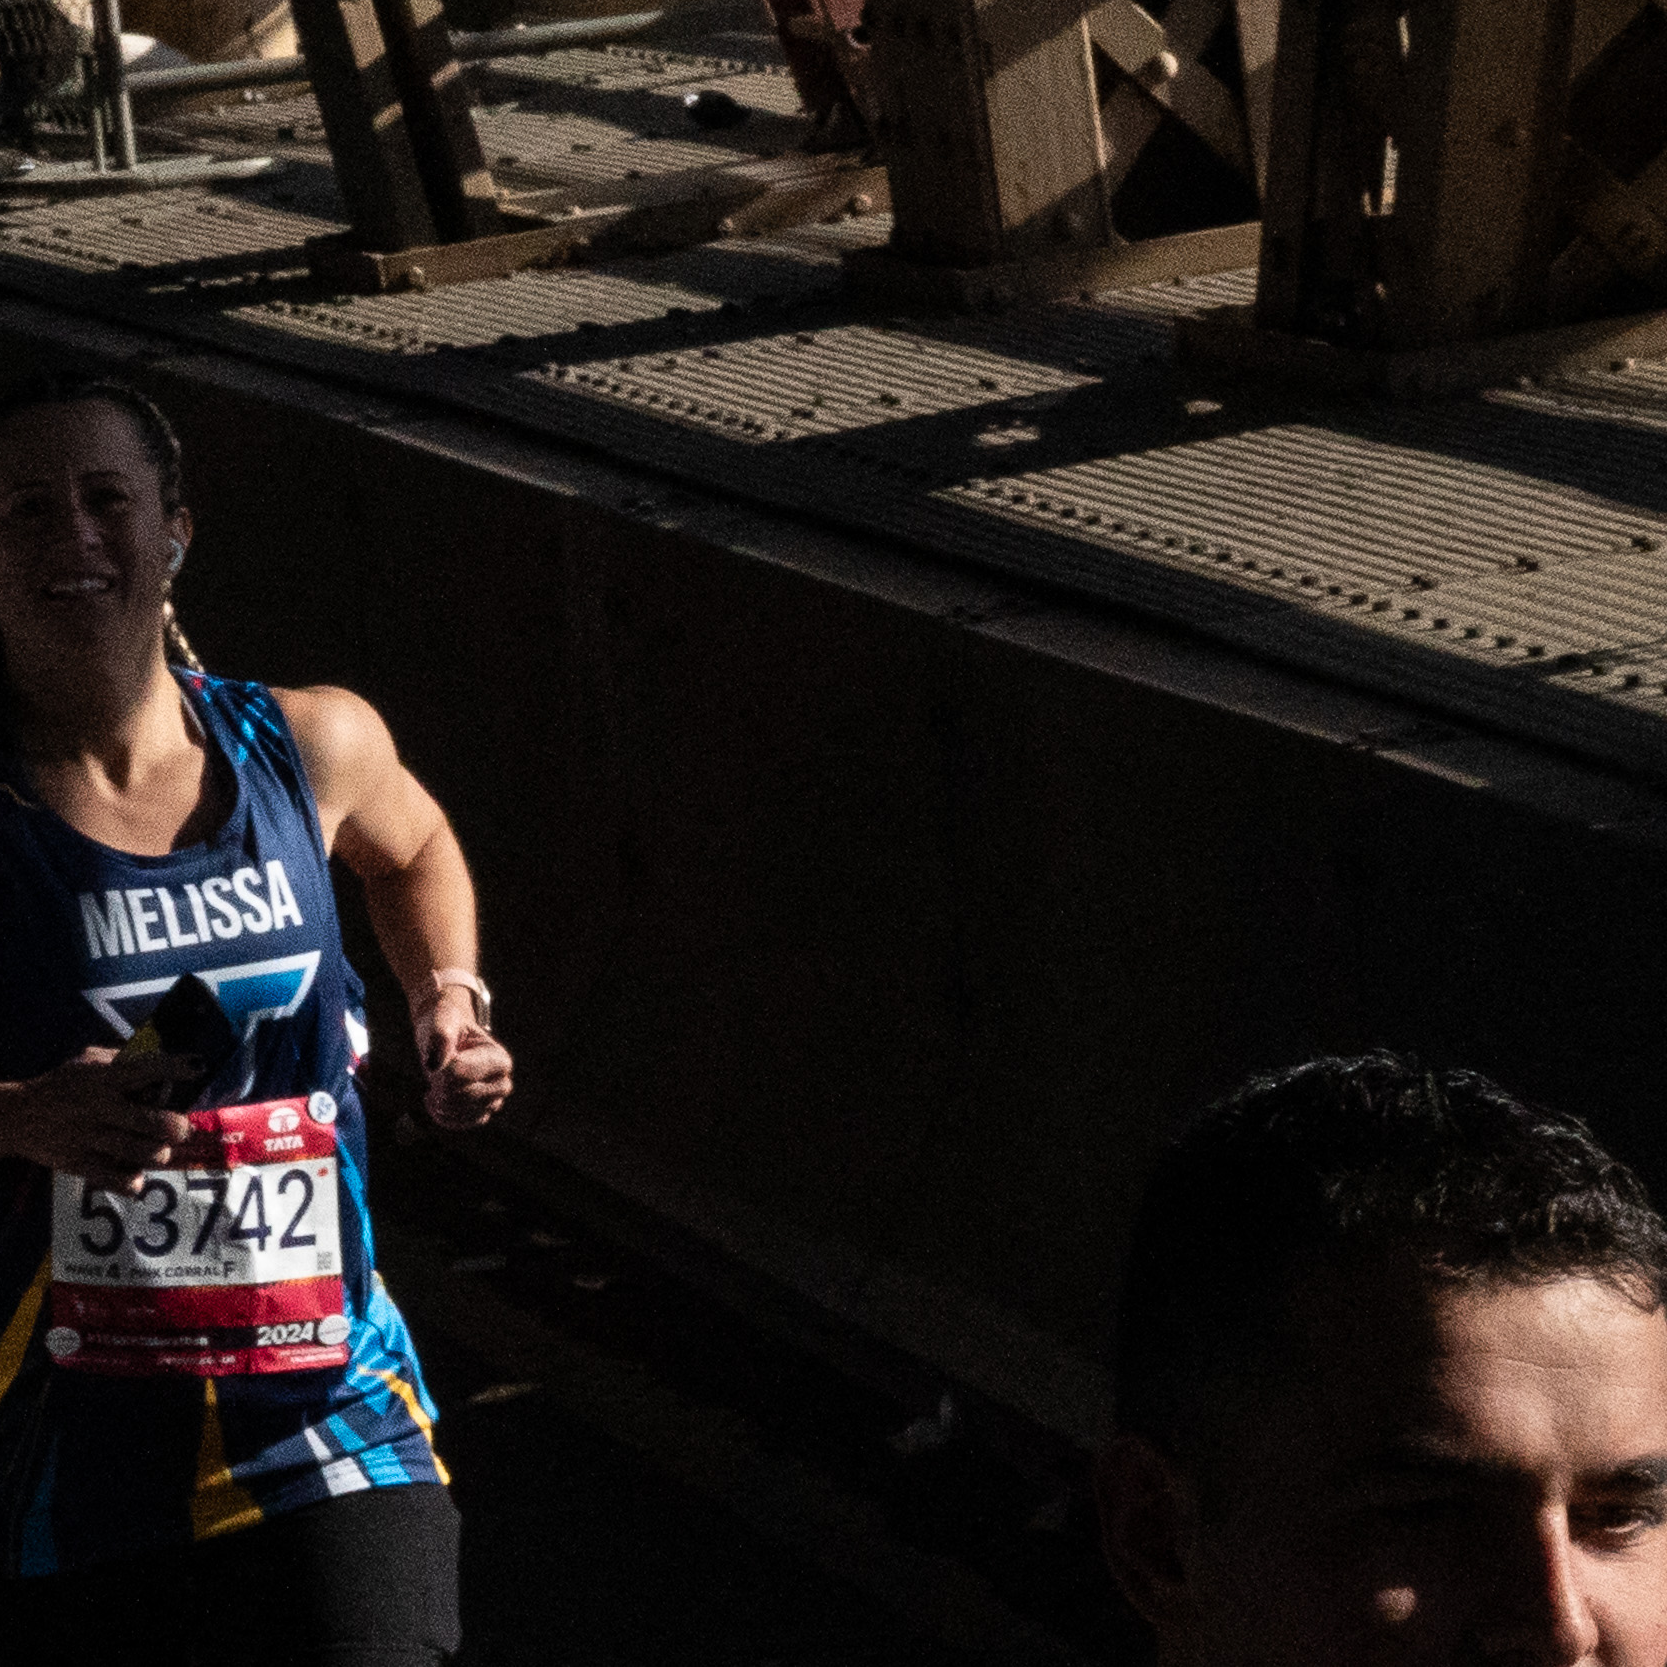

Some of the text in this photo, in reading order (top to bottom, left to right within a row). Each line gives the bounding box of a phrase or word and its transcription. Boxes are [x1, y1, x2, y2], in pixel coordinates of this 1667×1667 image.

[77, 859, 304, 960] MELISSA
[264, 1134, 305, 1153] TATA
[78, 1168, 318, 1257] 53742
[164, 1264, 221, 1278] CORRAL
[223, 1260, 236, 1278] F
[255, 1323, 316, 1347] 2024
